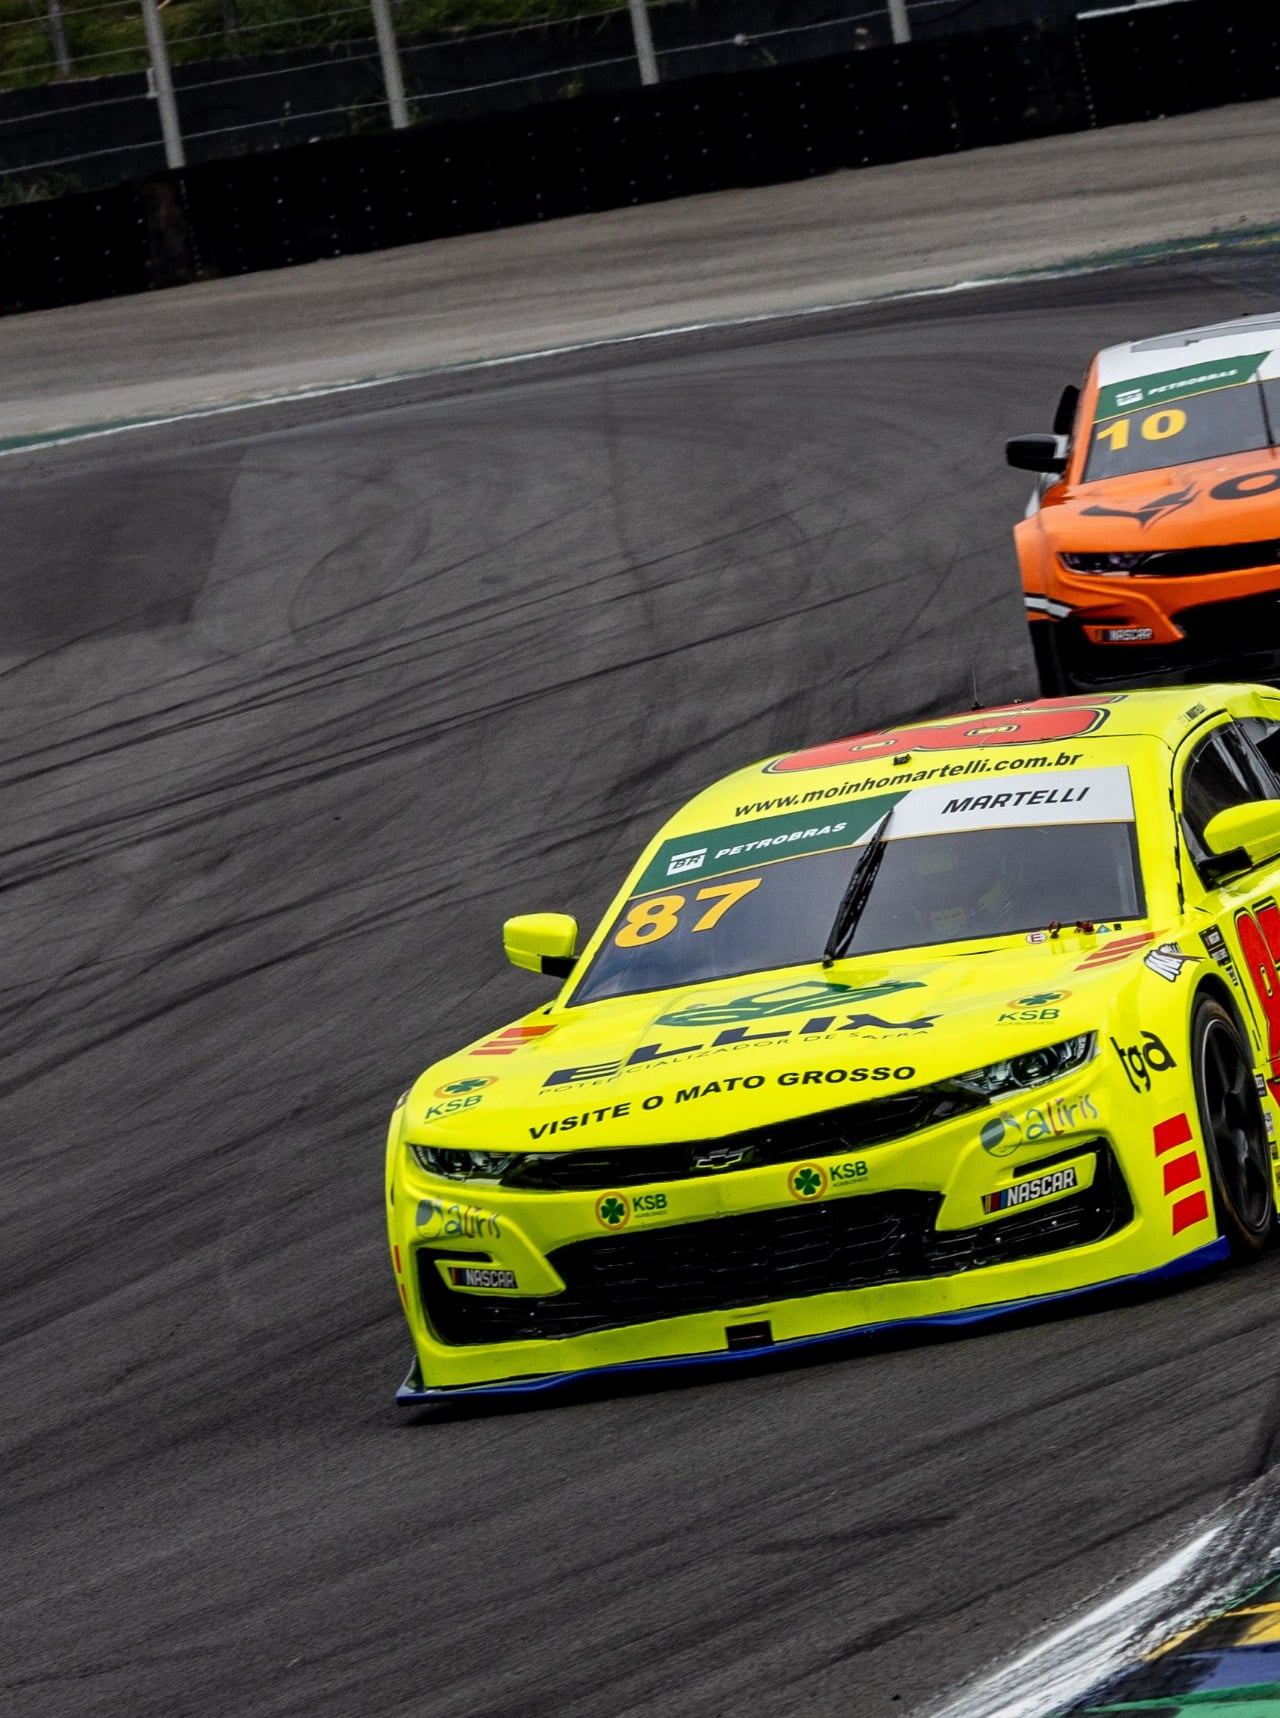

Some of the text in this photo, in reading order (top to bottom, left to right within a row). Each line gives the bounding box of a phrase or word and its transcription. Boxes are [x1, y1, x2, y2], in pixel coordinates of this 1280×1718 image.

[1096, 409, 1188, 451] 10
[1107, 627, 1154, 642] NASCAR
[734, 752, 1083, 818] www.moinhomartelli.com.br
[941, 786, 1090, 815] MARTELLI
[714, 822, 848, 859] PETROBRAS
[614, 878, 763, 948] 87
[998, 1008, 1060, 1022] KSB
[541, 1013, 943, 1088] ELLIX
[802, 1031, 838, 1043] DE
[1109, 1030, 1178, 1094] tga
[425, 1095, 482, 1119] KSB
[528, 1066, 916, 1140] VISITE O MATO GROSSO
[830, 1160, 868, 1181] KSB
[633, 1193, 667, 1212] KSB
[1007, 1168, 1074, 1207] NASCAR
[465, 1268, 516, 1288] NASCAR
